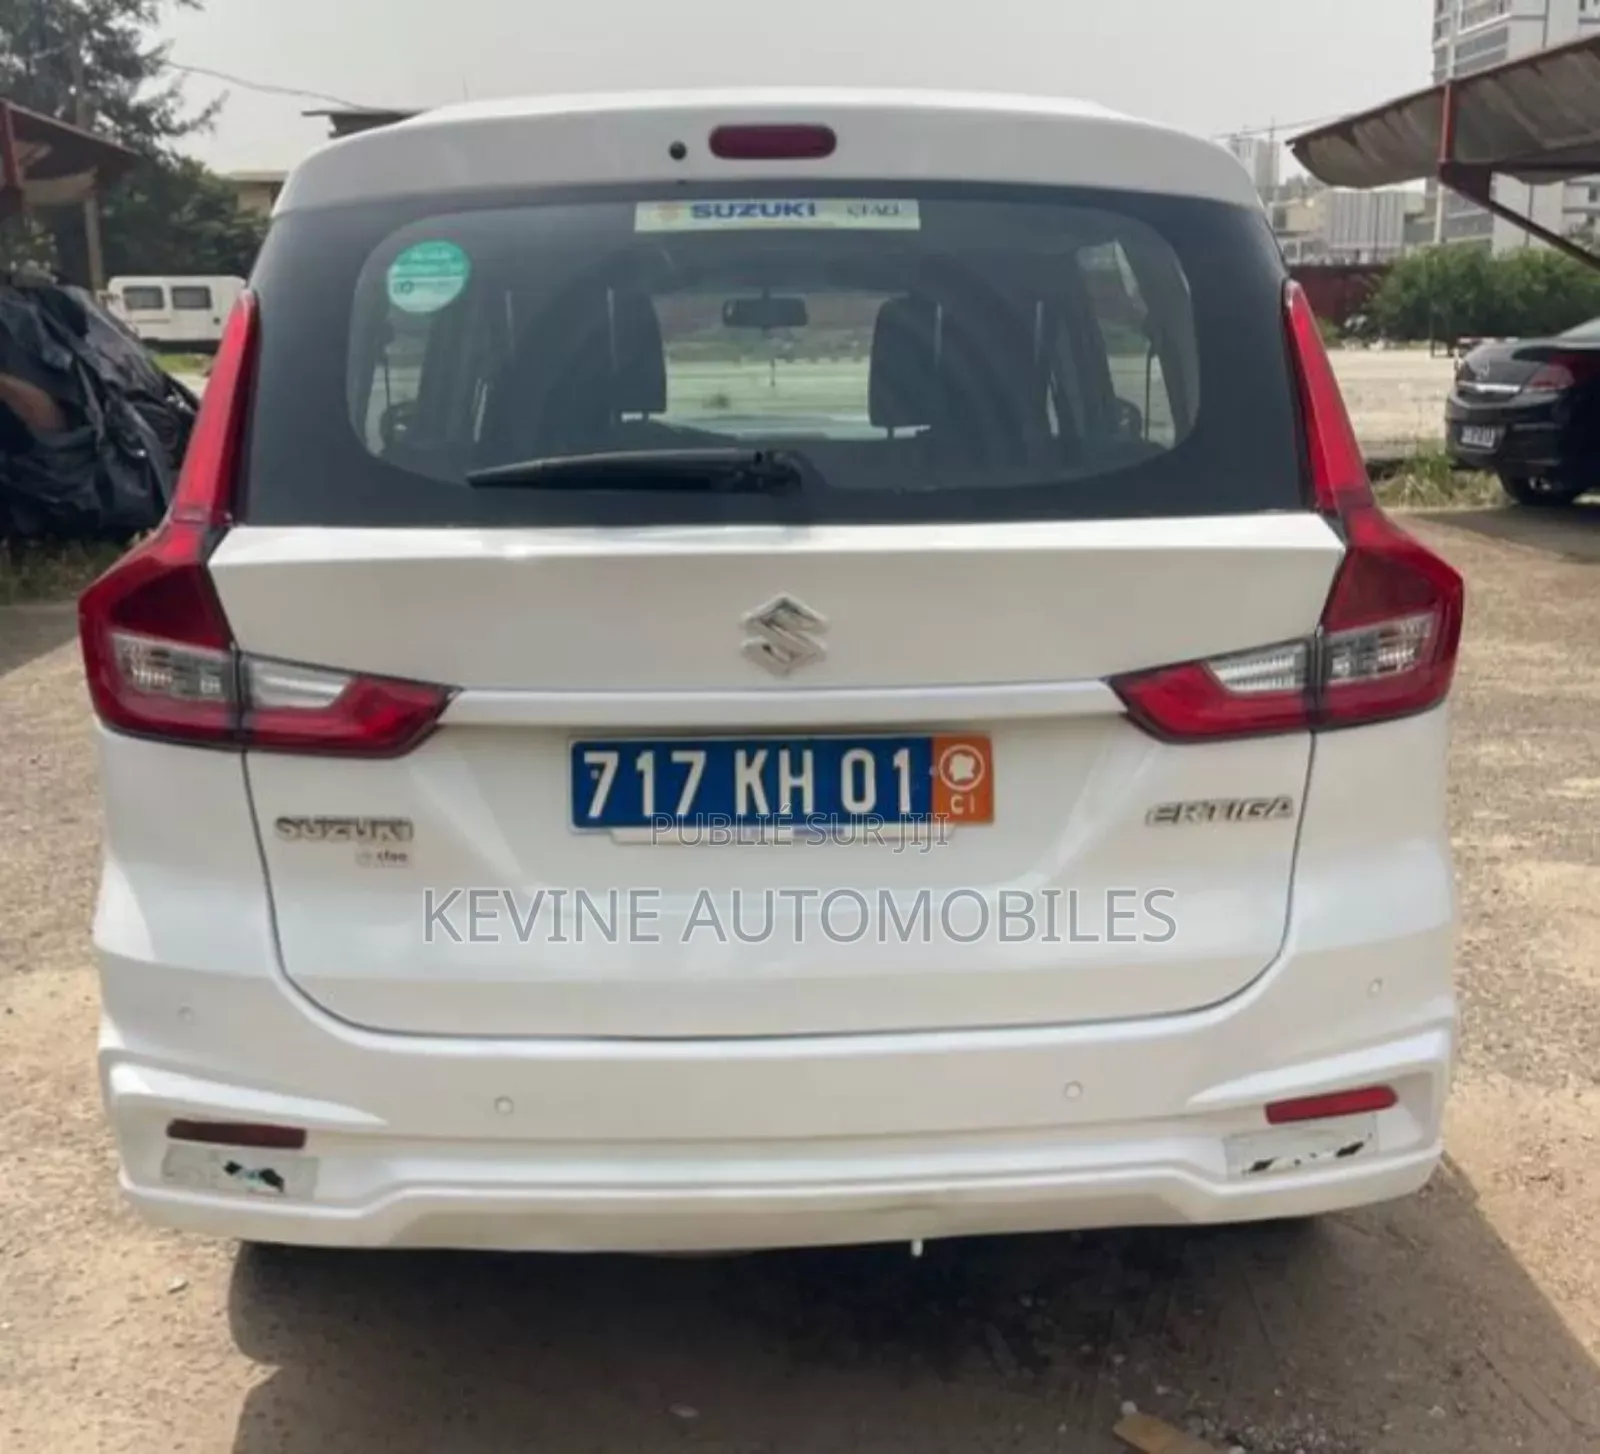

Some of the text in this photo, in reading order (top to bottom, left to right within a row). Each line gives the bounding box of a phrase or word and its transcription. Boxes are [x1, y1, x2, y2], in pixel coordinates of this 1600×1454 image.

[690, 202, 816, 219] SUZUKI
[584, 748, 911, 818] 717 KH 01
[1145, 795, 1294, 826] ERTIGA
[275, 816, 414, 843] SUZUKI
